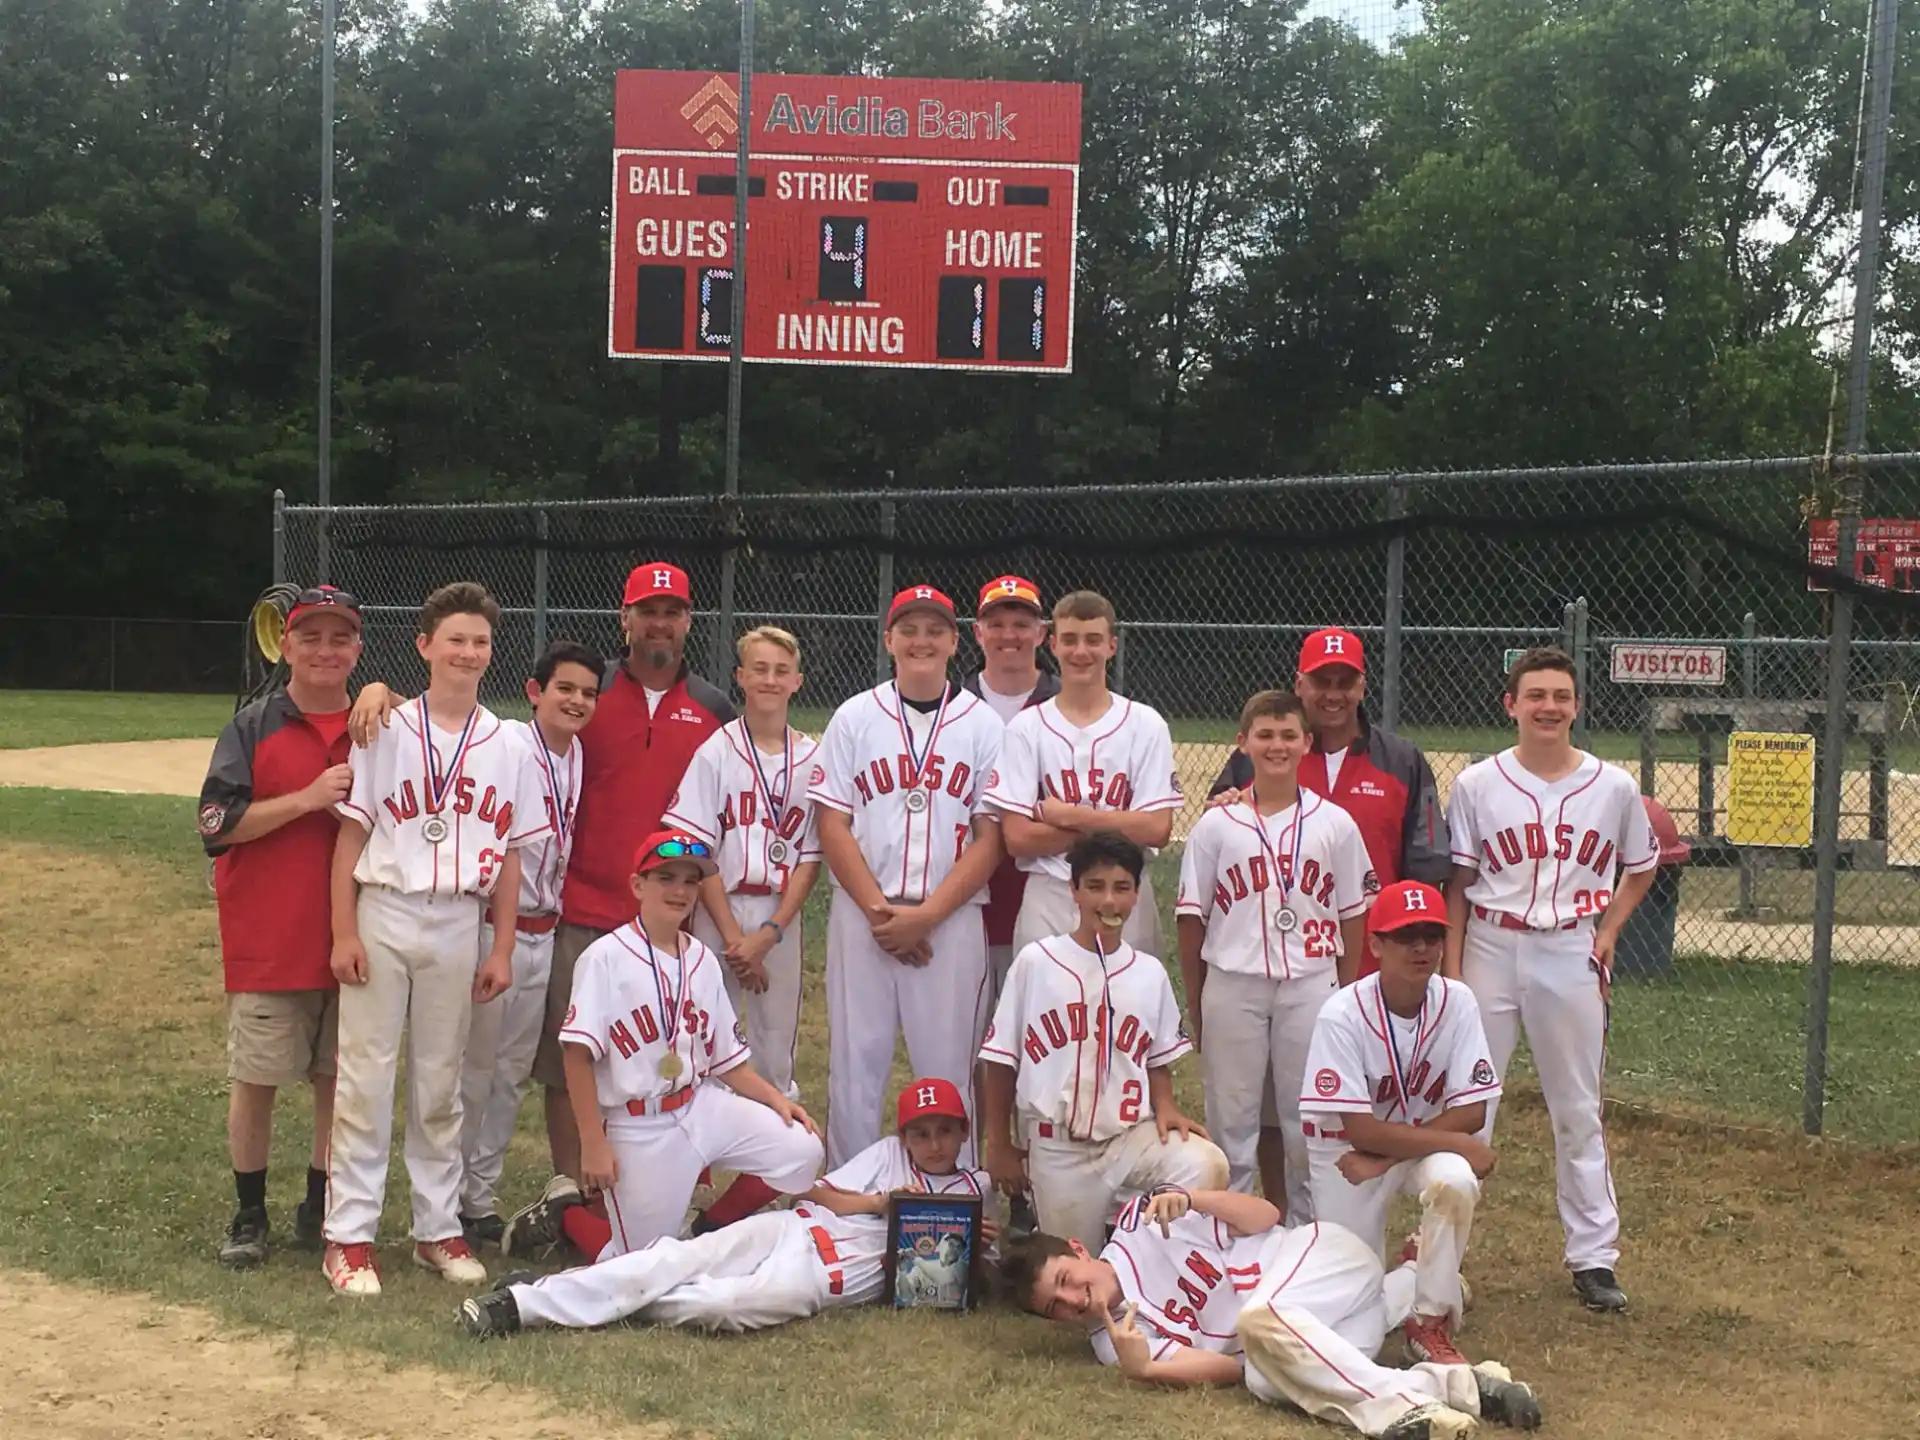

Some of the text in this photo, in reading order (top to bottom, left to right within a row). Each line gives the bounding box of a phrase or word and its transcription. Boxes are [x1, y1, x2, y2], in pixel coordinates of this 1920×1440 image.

[763, 92, 1018, 141] Avidia Bank
[628, 166, 691, 196] BALL
[776, 171, 869, 203] STRIKE
[946, 176, 1001, 207] OUT
[823, 222, 866, 290] 4
[945, 229, 1044, 269] HOME
[776, 313, 905, 355] INNING
[652, 570, 672, 589] H
[1324, 635, 1345, 654] H
[1622, 650, 1714, 676] VISITOR
[1735, 739, 1762, 749] PLEASE
[1403, 889, 1428, 911] H
[1303, 919, 1337, 958] 23
[916, 1086, 938, 1108] H
[1119, 1079, 1143, 1122] 2
